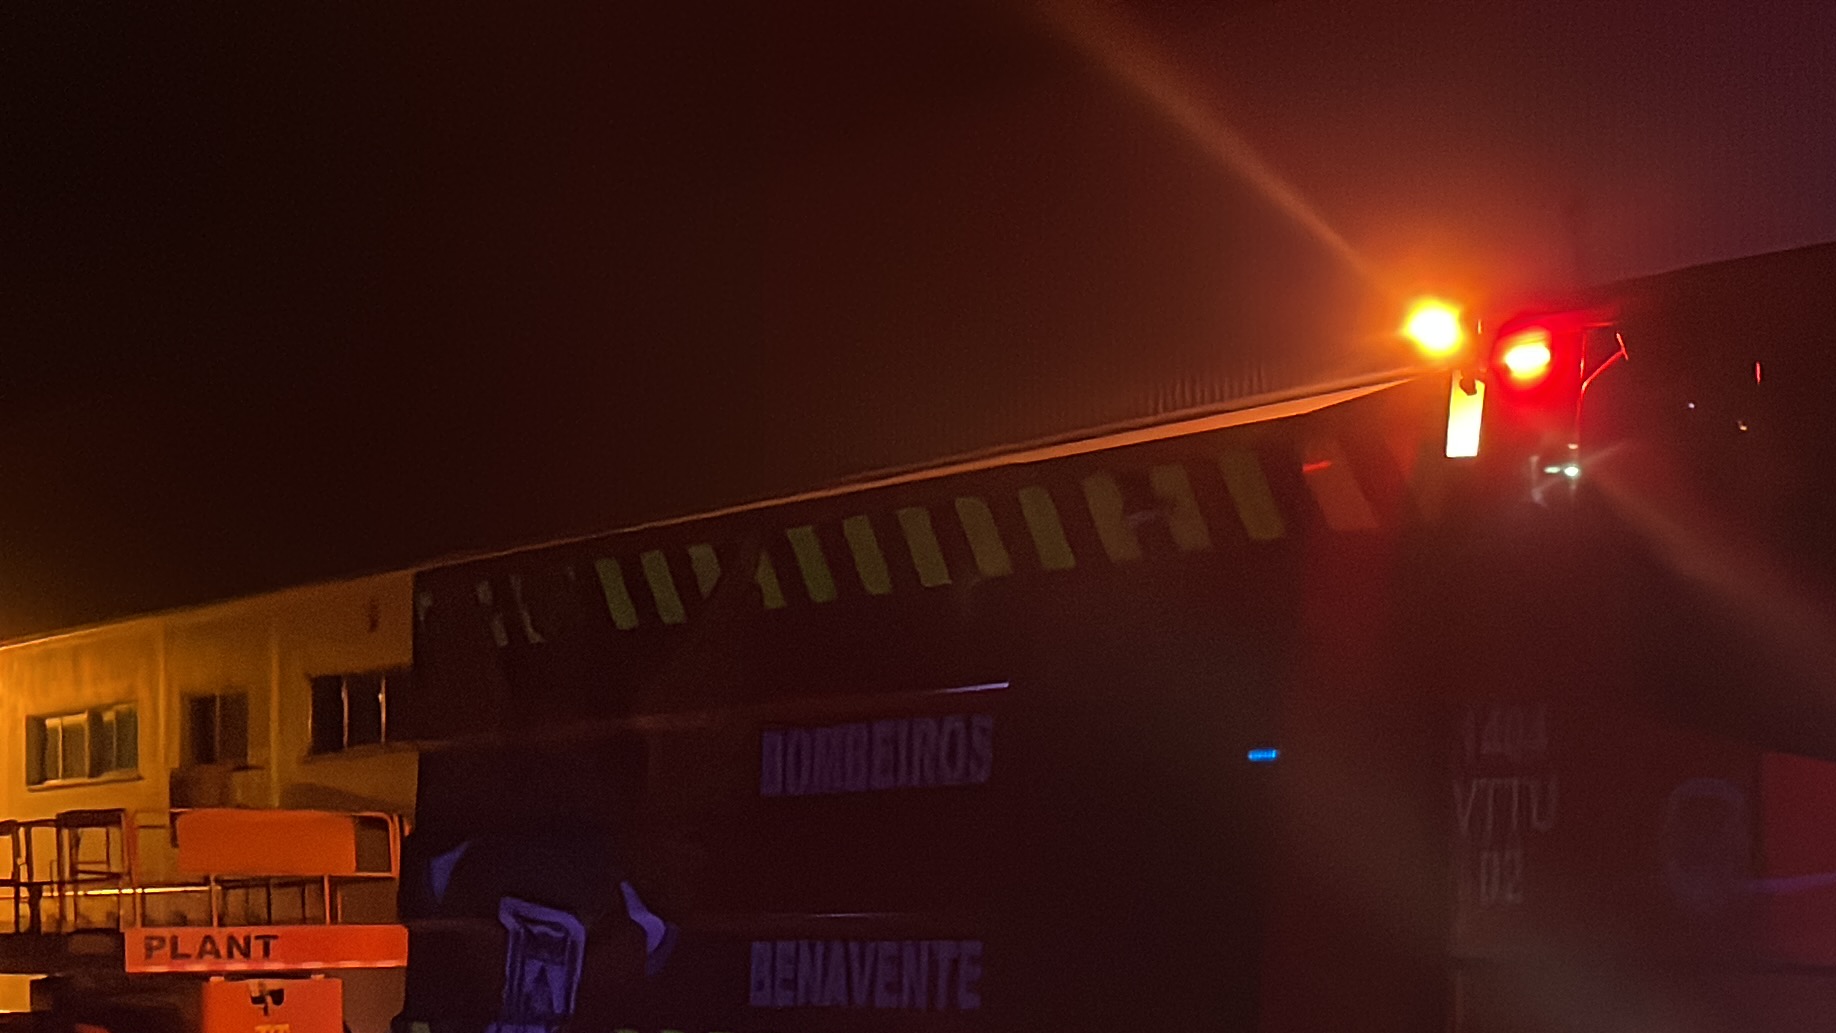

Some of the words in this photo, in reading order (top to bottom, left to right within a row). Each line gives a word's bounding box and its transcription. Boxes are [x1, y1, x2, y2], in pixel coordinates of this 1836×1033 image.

[760, 714, 992, 797] BOMBEIROS
[144, 934, 279, 960] PLANT
[751, 940, 983, 1009] BENAVENTE
